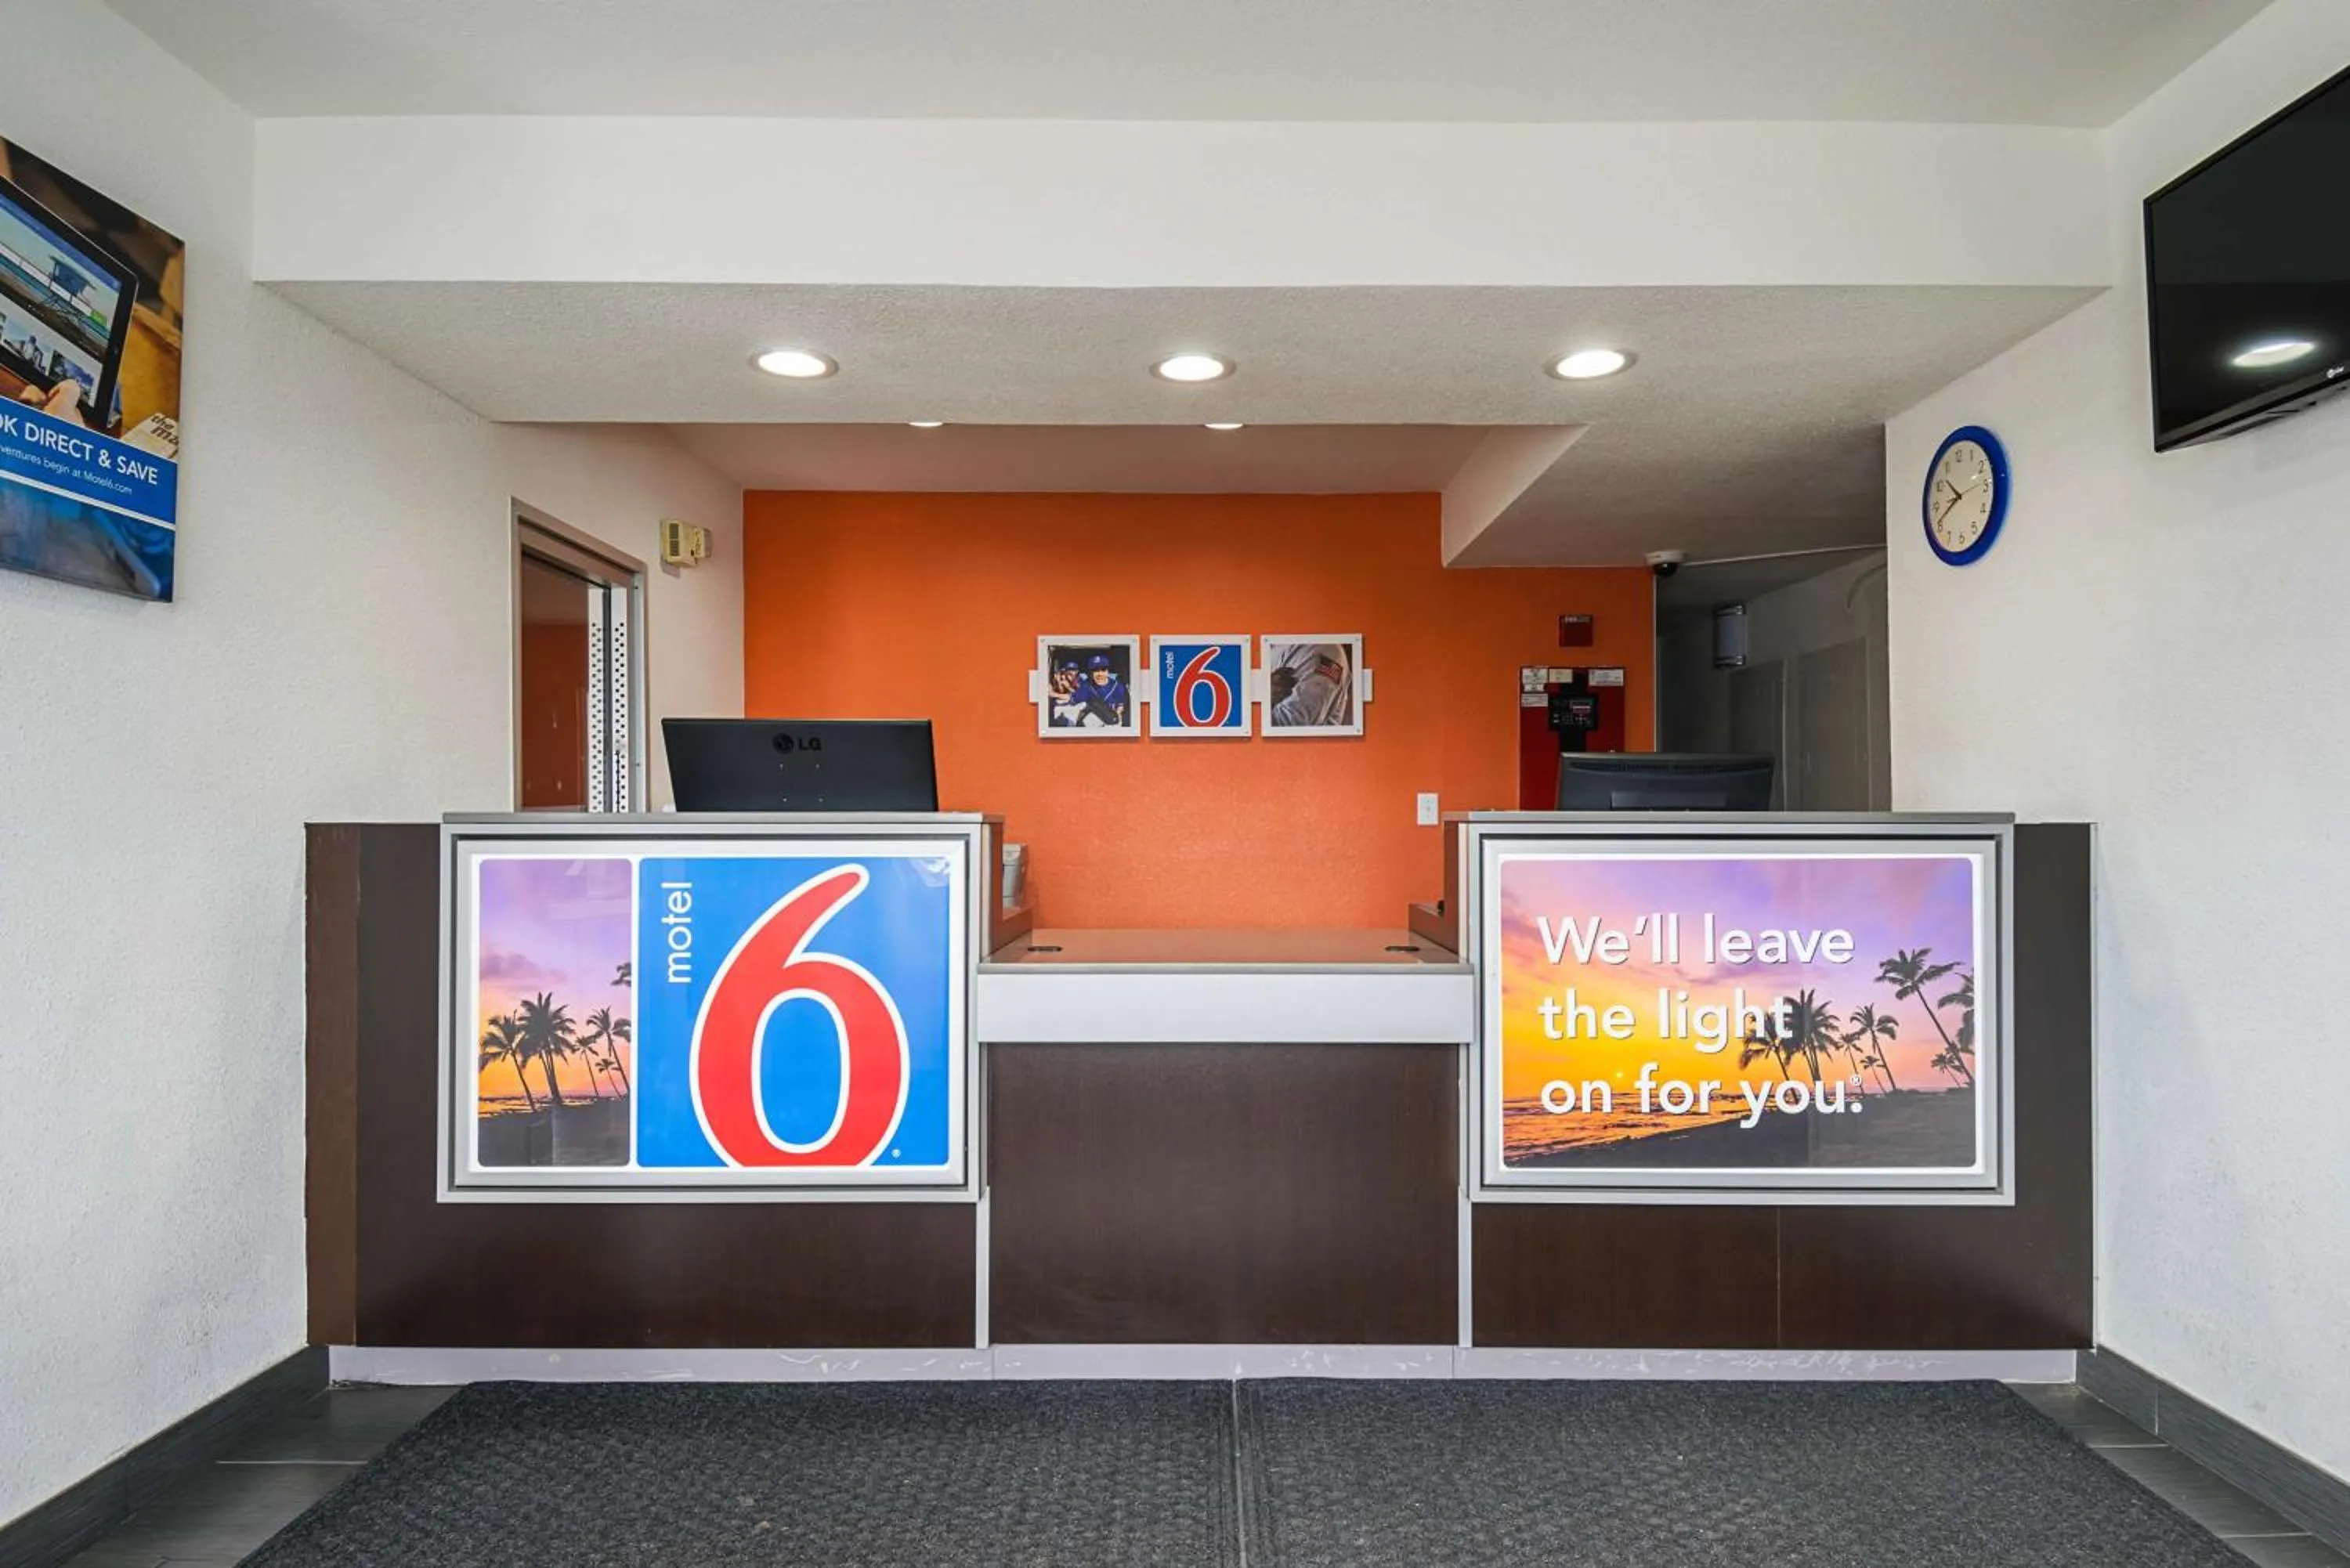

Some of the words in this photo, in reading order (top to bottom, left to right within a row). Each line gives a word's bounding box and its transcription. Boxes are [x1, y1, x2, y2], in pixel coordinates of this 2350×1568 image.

[25, 422, 94, 461] DIRECT
[98, 449, 111, 468] &
[117, 456, 158, 485] SAVE
[1165, 652, 1174, 679] motel
[1173, 646, 1231, 728] 6
[798, 737, 822, 751] LG
[1536, 912, 1681, 966] We'll
[1702, 912, 1855, 966] leave
[661, 881, 692, 985] motel
[689, 863, 910, 1167] 6
[1538, 988, 1636, 1040] the
[1658, 988, 1794, 1054] light
[1540, 1078, 1612, 1115] on
[1633, 1062, 1723, 1115] for
